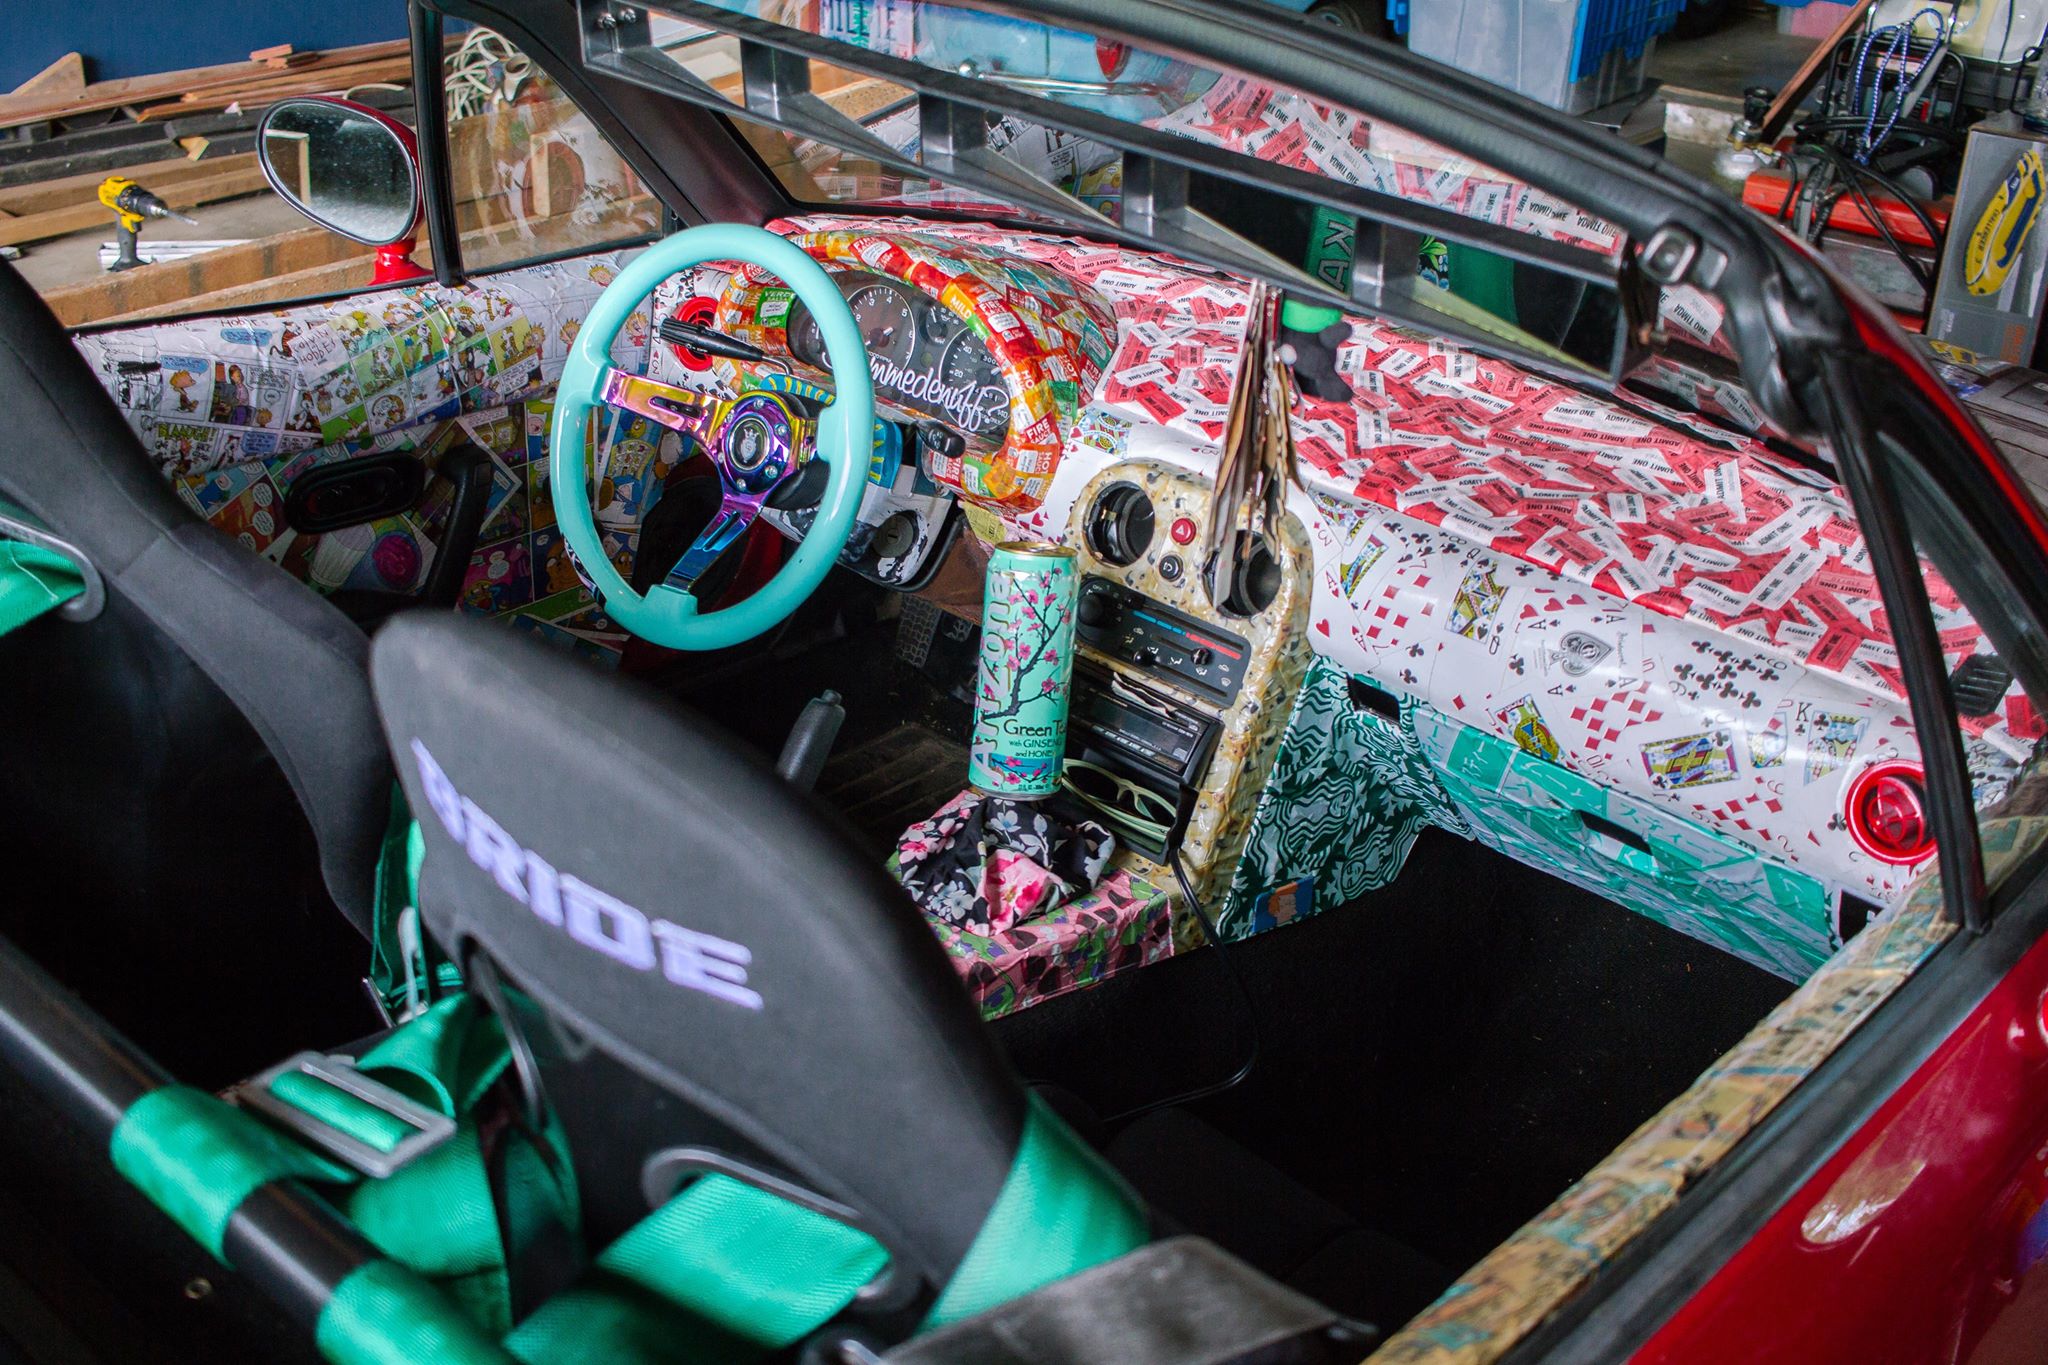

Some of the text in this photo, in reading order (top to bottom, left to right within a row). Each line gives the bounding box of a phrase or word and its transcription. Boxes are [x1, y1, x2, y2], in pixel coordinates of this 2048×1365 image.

[1116, 280, 1138, 289] ADMIT
[763, 289, 795, 299] VERDE
[886, 295, 894, 304] 4
[868, 297, 876, 307] 3
[949, 295, 973, 320] MILD
[901, 308, 909, 318] 5
[962, 344, 973, 355] 40
[953, 369, 964, 378] 20
[1142, 367, 1164, 377] ADMIT
[1472, 394, 1494, 406] ADMIT
[1553, 406, 1597, 418] ADMIT ONE
[1605, 414, 1631, 424] ADMIT
[1026, 417, 1051, 440] FIRE
[1546, 426, 1572, 435] ADMIT
[1493, 432, 1519, 443] ADMIT
[1582, 431, 1627, 444] ADMIT ONE
[1636, 436, 1682, 447] ADMIT ONE
[1042, 451, 1052, 474] HOT
[1632, 458, 1676, 475] ADMIT ONE
[1458, 477, 1484, 487] ADMIT
[1404, 485, 1448, 498] ADMIT ONE
[1525, 503, 1573, 515] ADMIT ONE
[1453, 513, 1495, 532] ADMIT ONE
[1465, 547, 1482, 560] Q
[1324, 570, 1338, 590] A
[1818, 581, 1871, 595] ADMIT ONE
[1695, 582, 1742, 607] ADMIT ONE
[1527, 618, 1548, 631] A
[1604, 614, 1627, 625] A
[1488, 635, 1501, 655] Q
[1618, 676, 1639, 689] A
[1546, 684, 1565, 696] A
[1795, 701, 1814, 724] K
[1003, 719, 1052, 736] Green
[1015, 750, 1028, 758] and
[410, 736, 764, 1011] BRIDE
